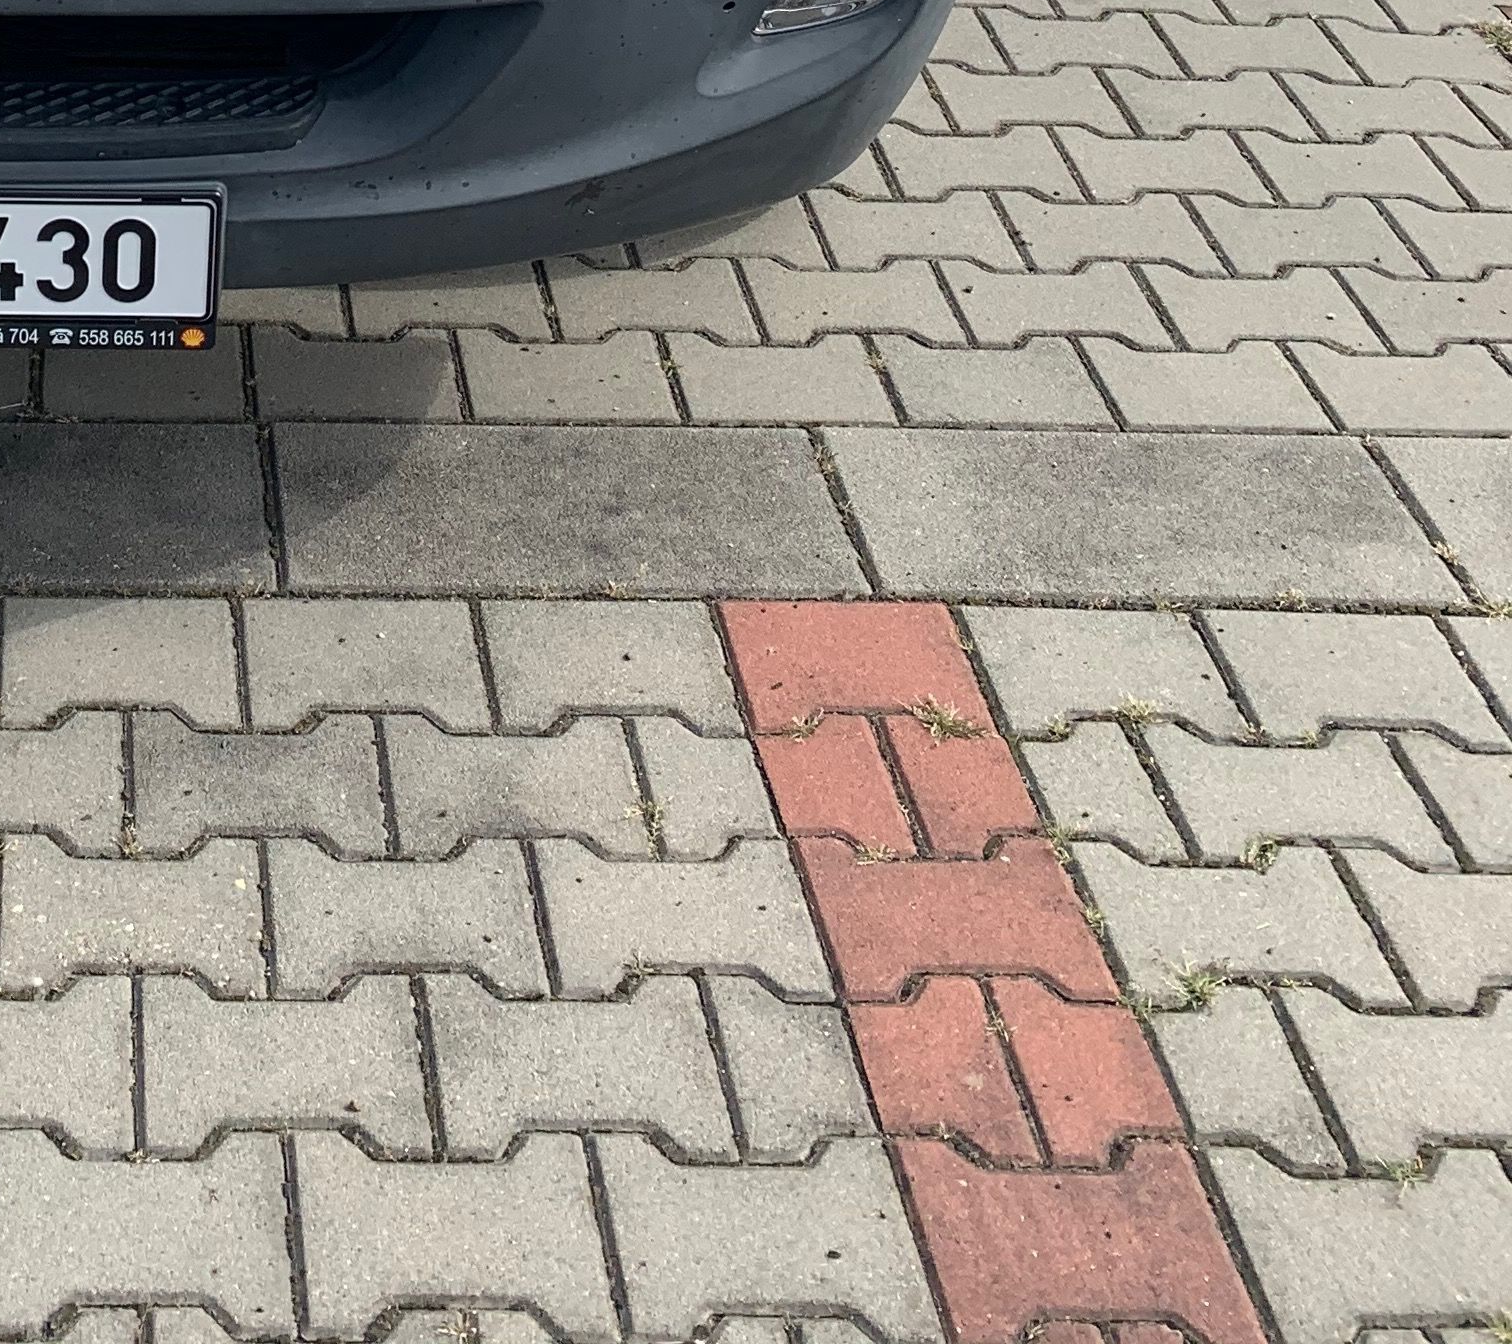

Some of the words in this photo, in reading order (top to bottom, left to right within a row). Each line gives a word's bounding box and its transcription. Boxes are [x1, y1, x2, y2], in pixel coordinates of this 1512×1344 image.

[9, 328, 39, 345] 704
[78, 329, 110, 346] 558
[113, 330, 144, 347] 665
[149, 330, 176, 347] 111
